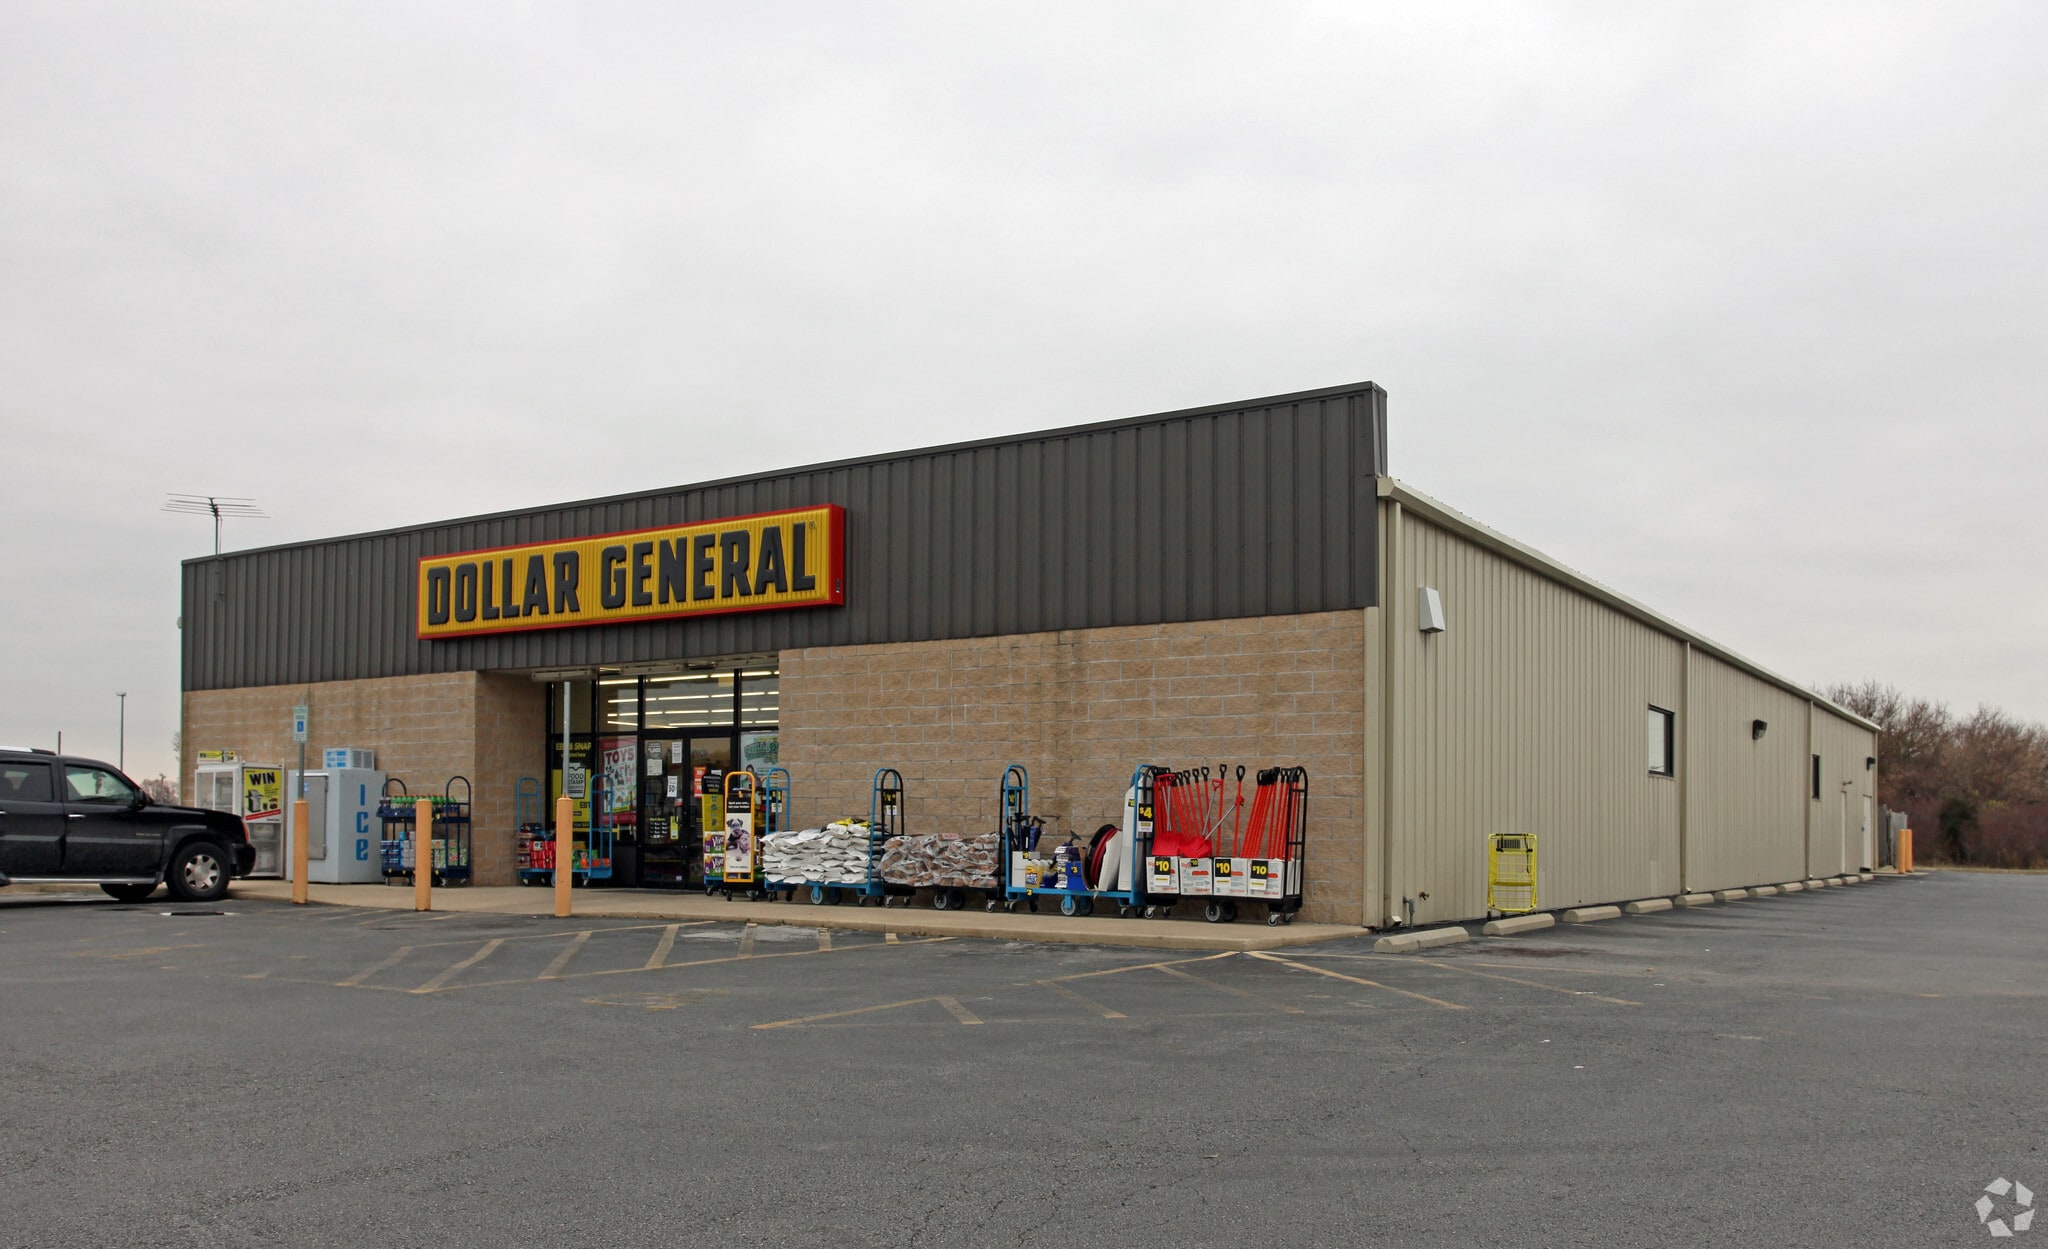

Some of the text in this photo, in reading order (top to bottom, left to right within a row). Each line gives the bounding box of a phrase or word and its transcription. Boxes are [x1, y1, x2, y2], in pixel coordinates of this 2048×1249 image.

[427, 522, 817, 625] DOLLAR GENERAL
[574, 741, 592, 751] SNAP
[605, 747, 635, 764] TOYS
[249, 771, 276, 786] WIN
[1139, 806, 1153, 819] $4
[1155, 860, 1170, 872] $10
[1215, 862, 1231, 874] $10
[1252, 865, 1267, 875] $10
